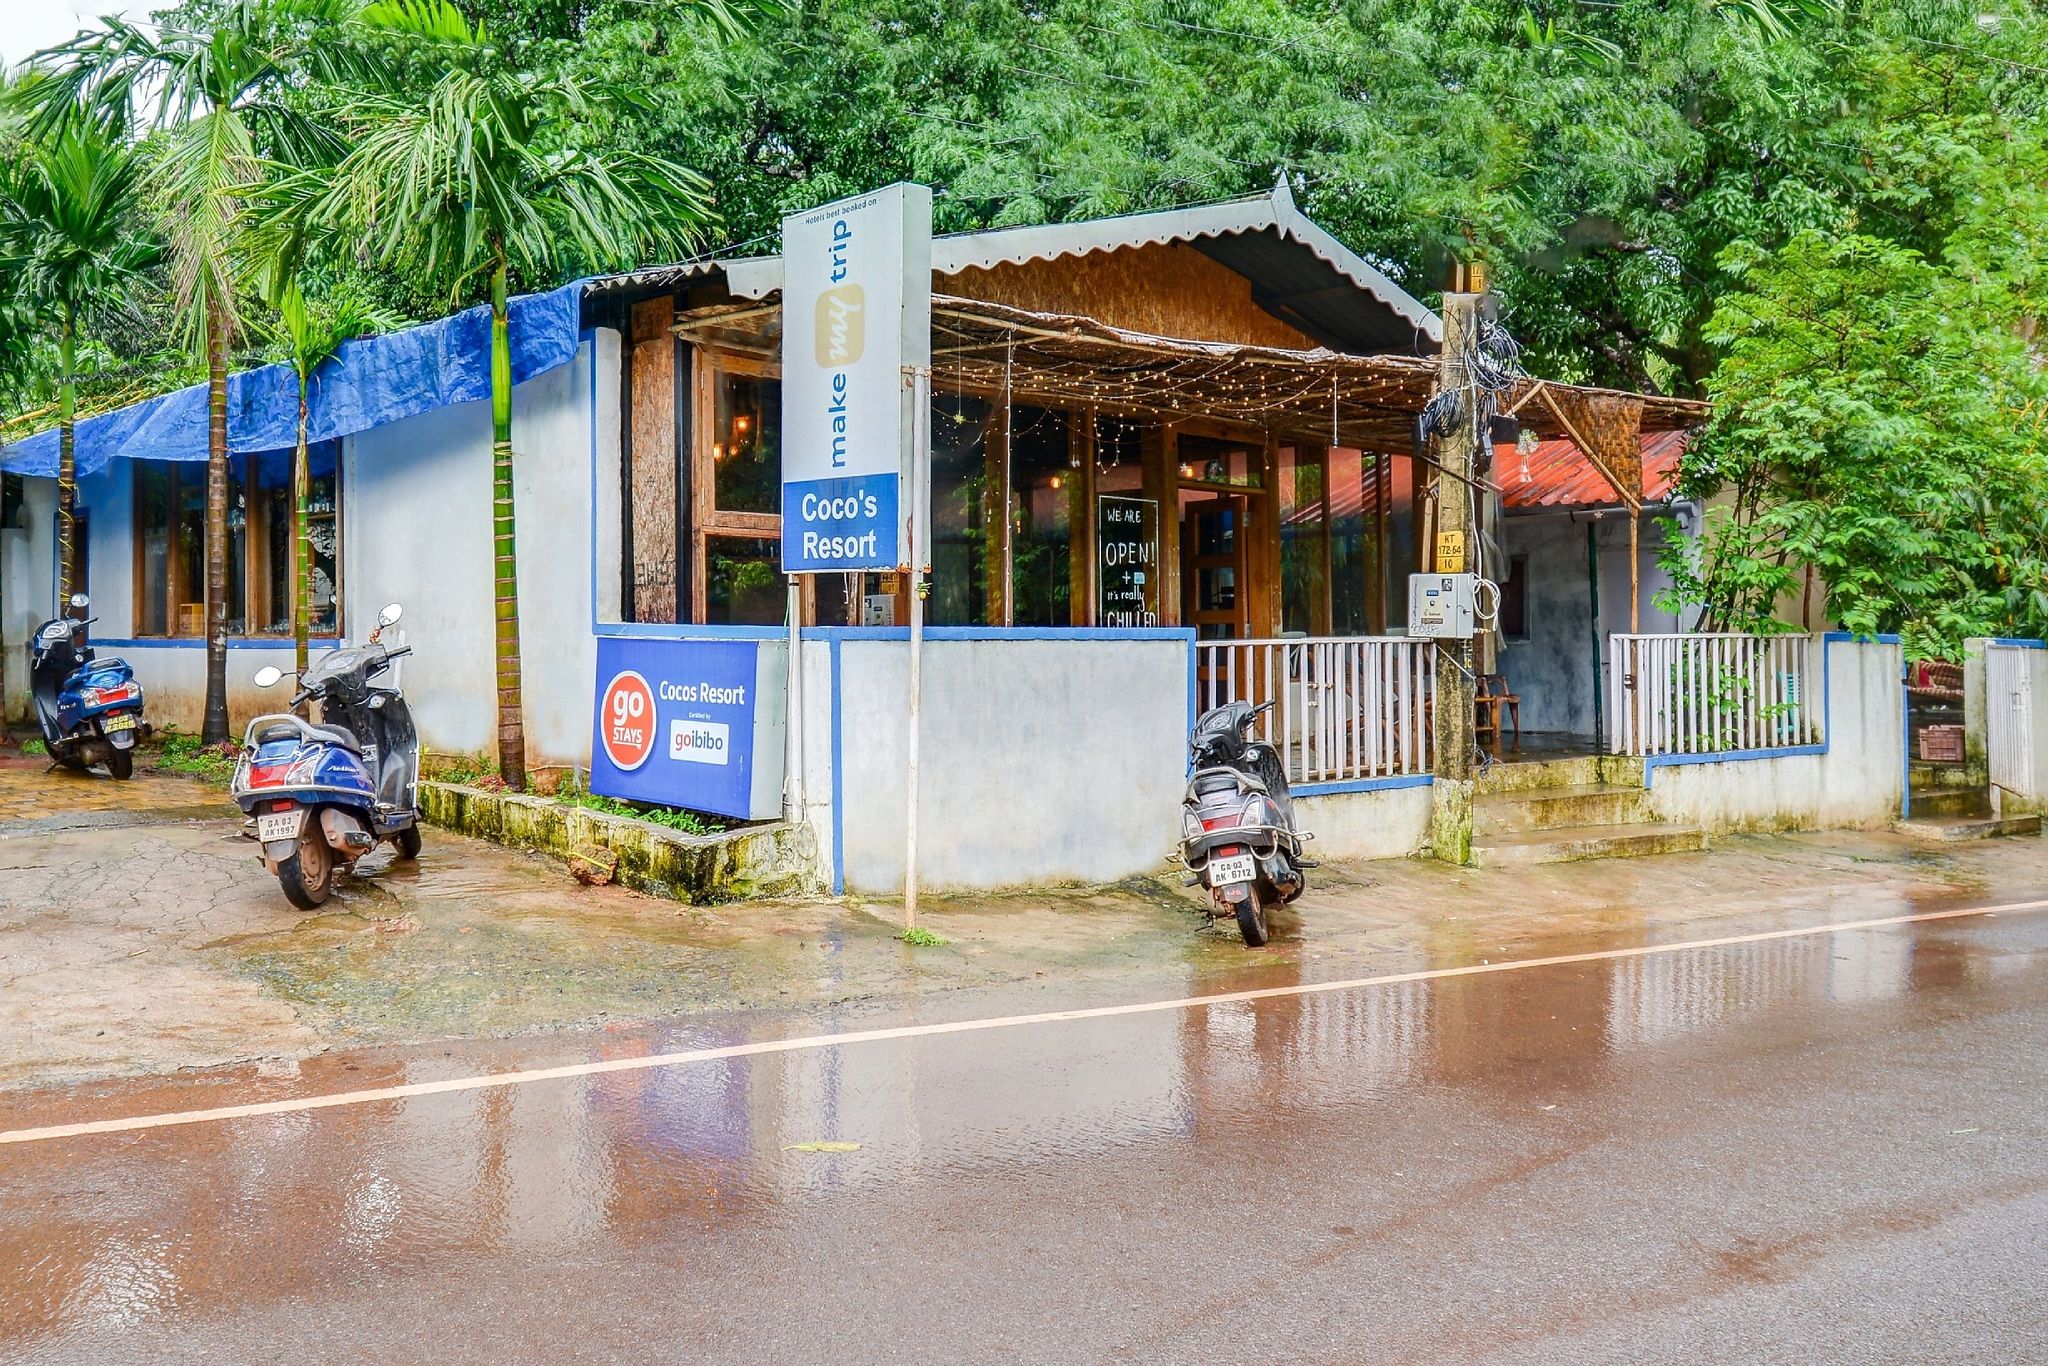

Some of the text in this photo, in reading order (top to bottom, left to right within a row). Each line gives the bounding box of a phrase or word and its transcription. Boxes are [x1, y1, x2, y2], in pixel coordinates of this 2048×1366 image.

[805, 197, 878, 226] Hotels best booked on
[827, 219, 862, 468] make my trip
[802, 488, 878, 523] Coco's
[1107, 508, 1142, 524] WE ARE
[803, 529, 877, 561] Resort
[1105, 542, 1156, 568] OPEN!
[1444, 558, 1453, 570] 10
[1120, 584, 1146, 612] really
[659, 680, 746, 706] Cocos Resort
[613, 688, 645, 727] go
[613, 726, 643, 745] STAYS
[675, 729, 724, 752] goibibo
[267, 817, 292, 828] GA 03
